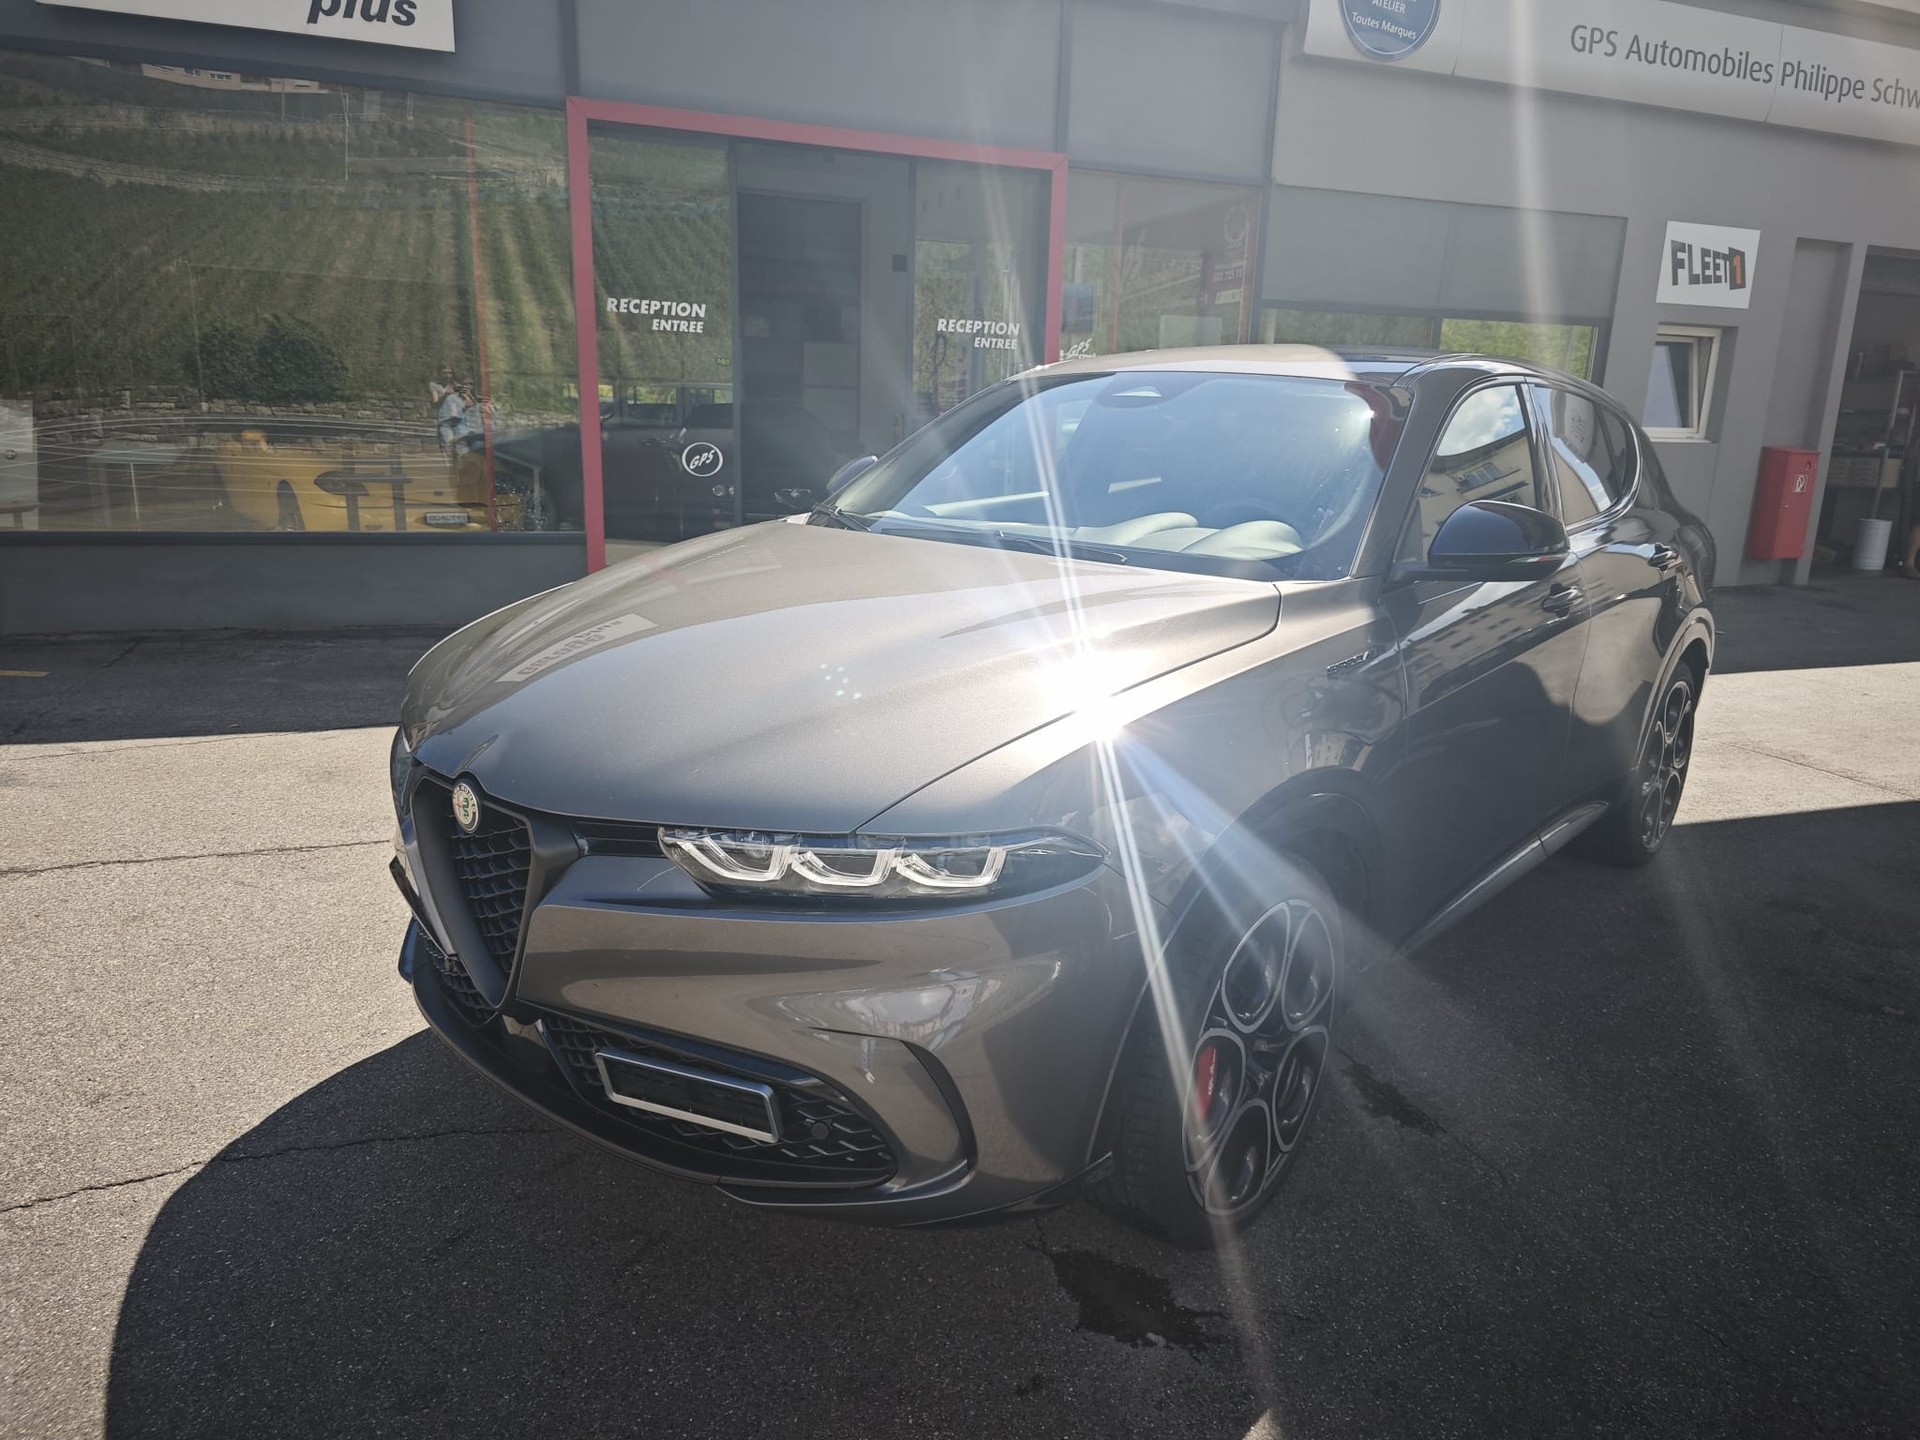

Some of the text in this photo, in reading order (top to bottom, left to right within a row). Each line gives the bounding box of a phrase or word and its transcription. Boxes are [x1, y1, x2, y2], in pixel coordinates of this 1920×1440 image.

[307, 0, 417, 26] plus
[1352, 12, 1417, 40] Toutes Marques
[1570, 24, 1618, 57] GPS
[1624, 34, 1774, 84] Automobiles
[1780, 61, 1865, 103] Philippe
[606, 297, 707, 318] RECEPTION
[652, 318, 704, 334] ENTREE
[937, 318, 1020, 335] RECEPTION
[973, 337, 1018, 350] ENTREE
[690, 449, 716, 470] GPS
